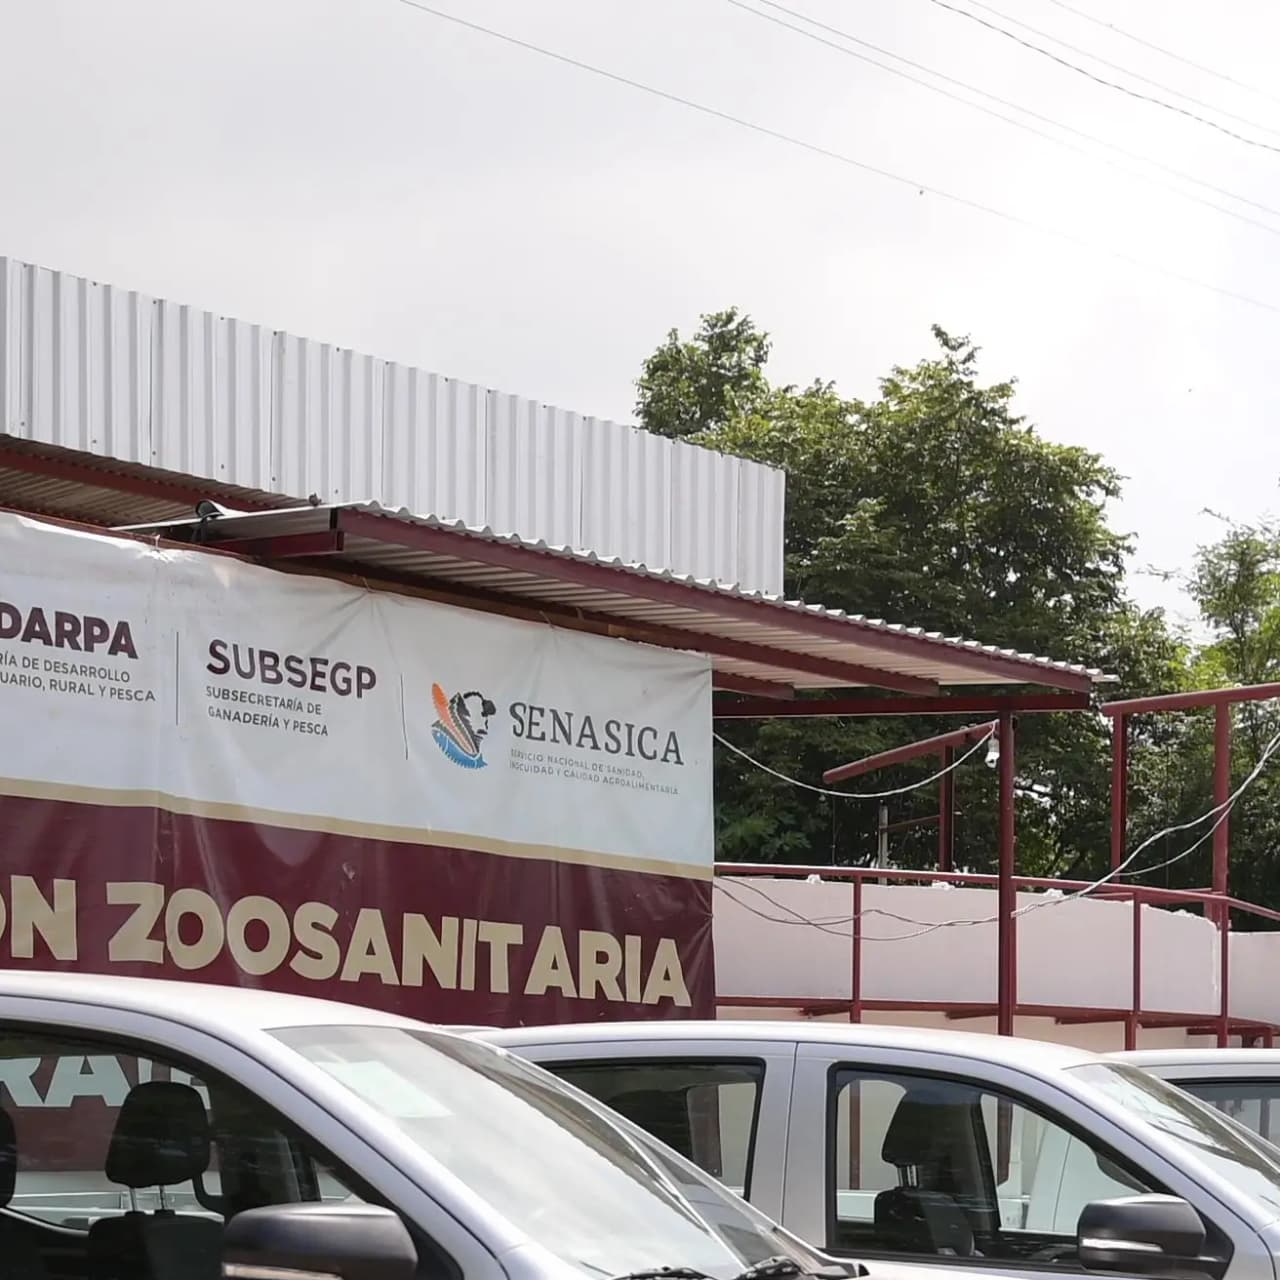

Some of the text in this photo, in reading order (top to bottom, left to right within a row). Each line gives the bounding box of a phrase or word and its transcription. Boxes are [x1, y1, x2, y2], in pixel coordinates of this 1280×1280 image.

[22, 656, 39, 670] DE
[44, 660, 130, 683] DESARROLLO
[206, 639, 377, 699] SUBSEGP
[50, 679, 94, 696] RURAL
[99, 685, 107, 697] Y
[110, 687, 156, 702] PESCA
[206, 686, 322, 715] SUBSECRETARÍA DE
[208, 706, 328, 736] GANADERÍA Y PESCA
[509, 702, 685, 765] SENASICA
[591, 763, 604, 772] DE
[107, 878, 693, 1009] ZOOSANITARIA
